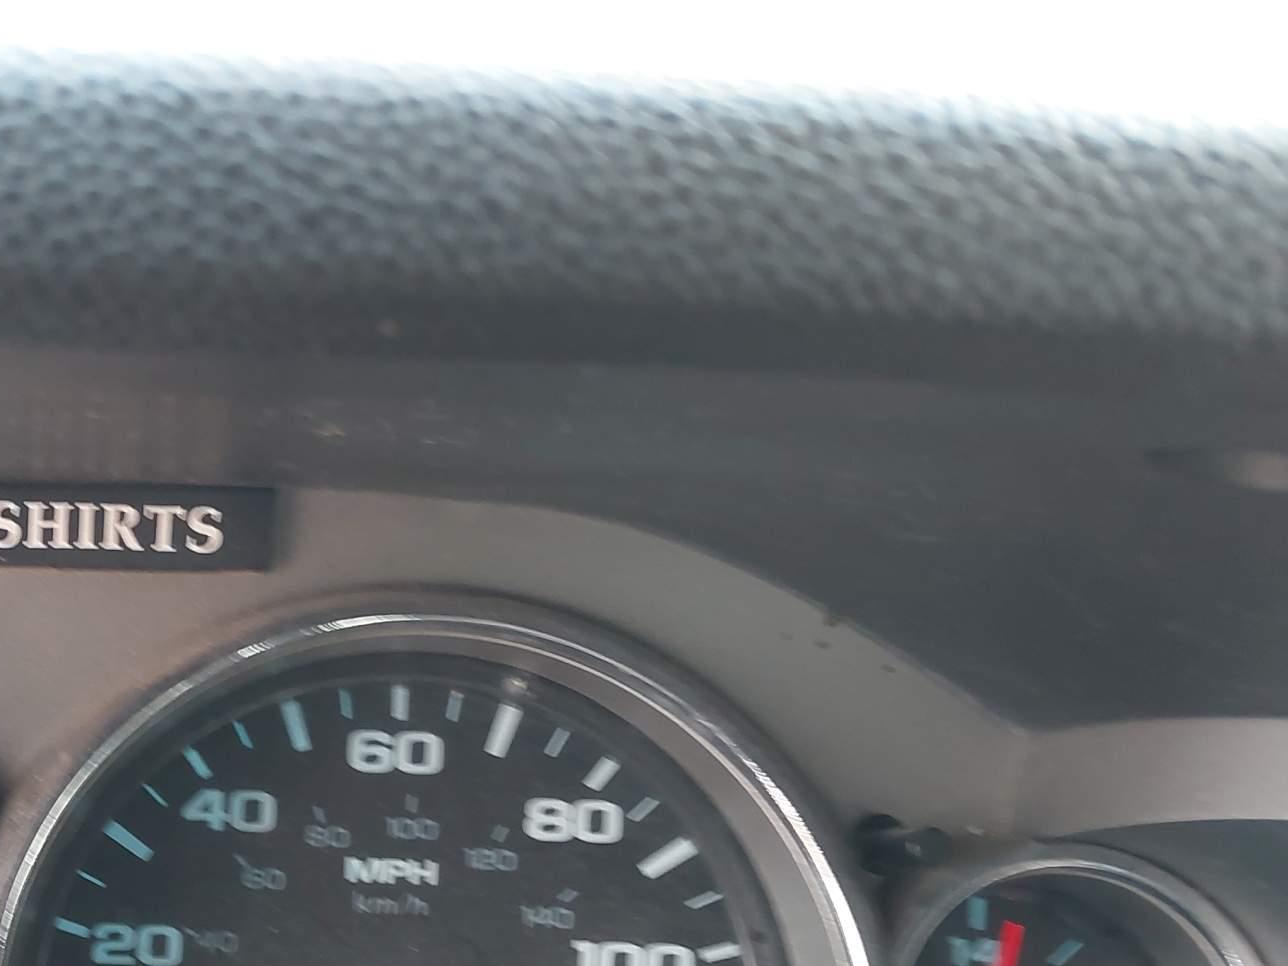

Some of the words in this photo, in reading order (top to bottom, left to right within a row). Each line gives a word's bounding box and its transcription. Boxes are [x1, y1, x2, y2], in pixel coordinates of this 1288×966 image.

[345, 729, 445, 775] 60
[180, 788, 278, 833] 40
[522, 797, 624, 844] 80
[303, 825, 352, 848] 80
[385, 816, 440, 840] 100
[343, 856, 439, 886] MPH
[464, 847, 519, 871] 120
[352, 890, 429, 916] km/h
[520, 905, 575, 929] 140
[90, 923, 184, 966] 20
